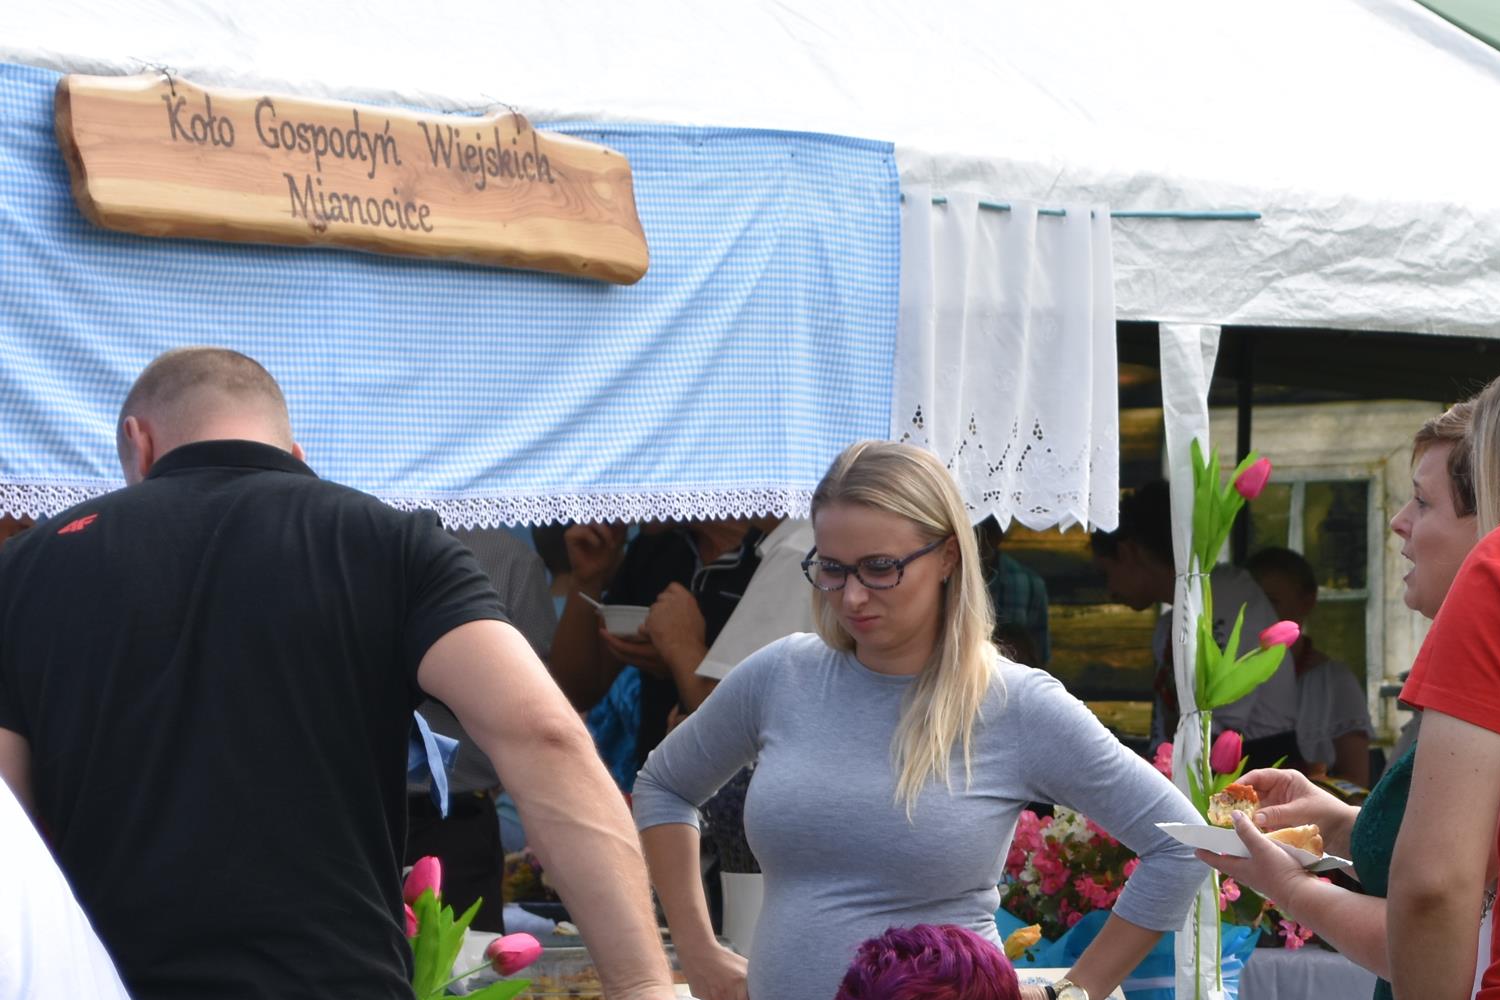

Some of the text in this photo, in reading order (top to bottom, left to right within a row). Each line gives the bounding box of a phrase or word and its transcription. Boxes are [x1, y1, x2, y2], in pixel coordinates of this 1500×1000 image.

[162, 94, 555, 190] Koło Gospodyń Wiejskich
[283, 172, 434, 232] Mianocice
